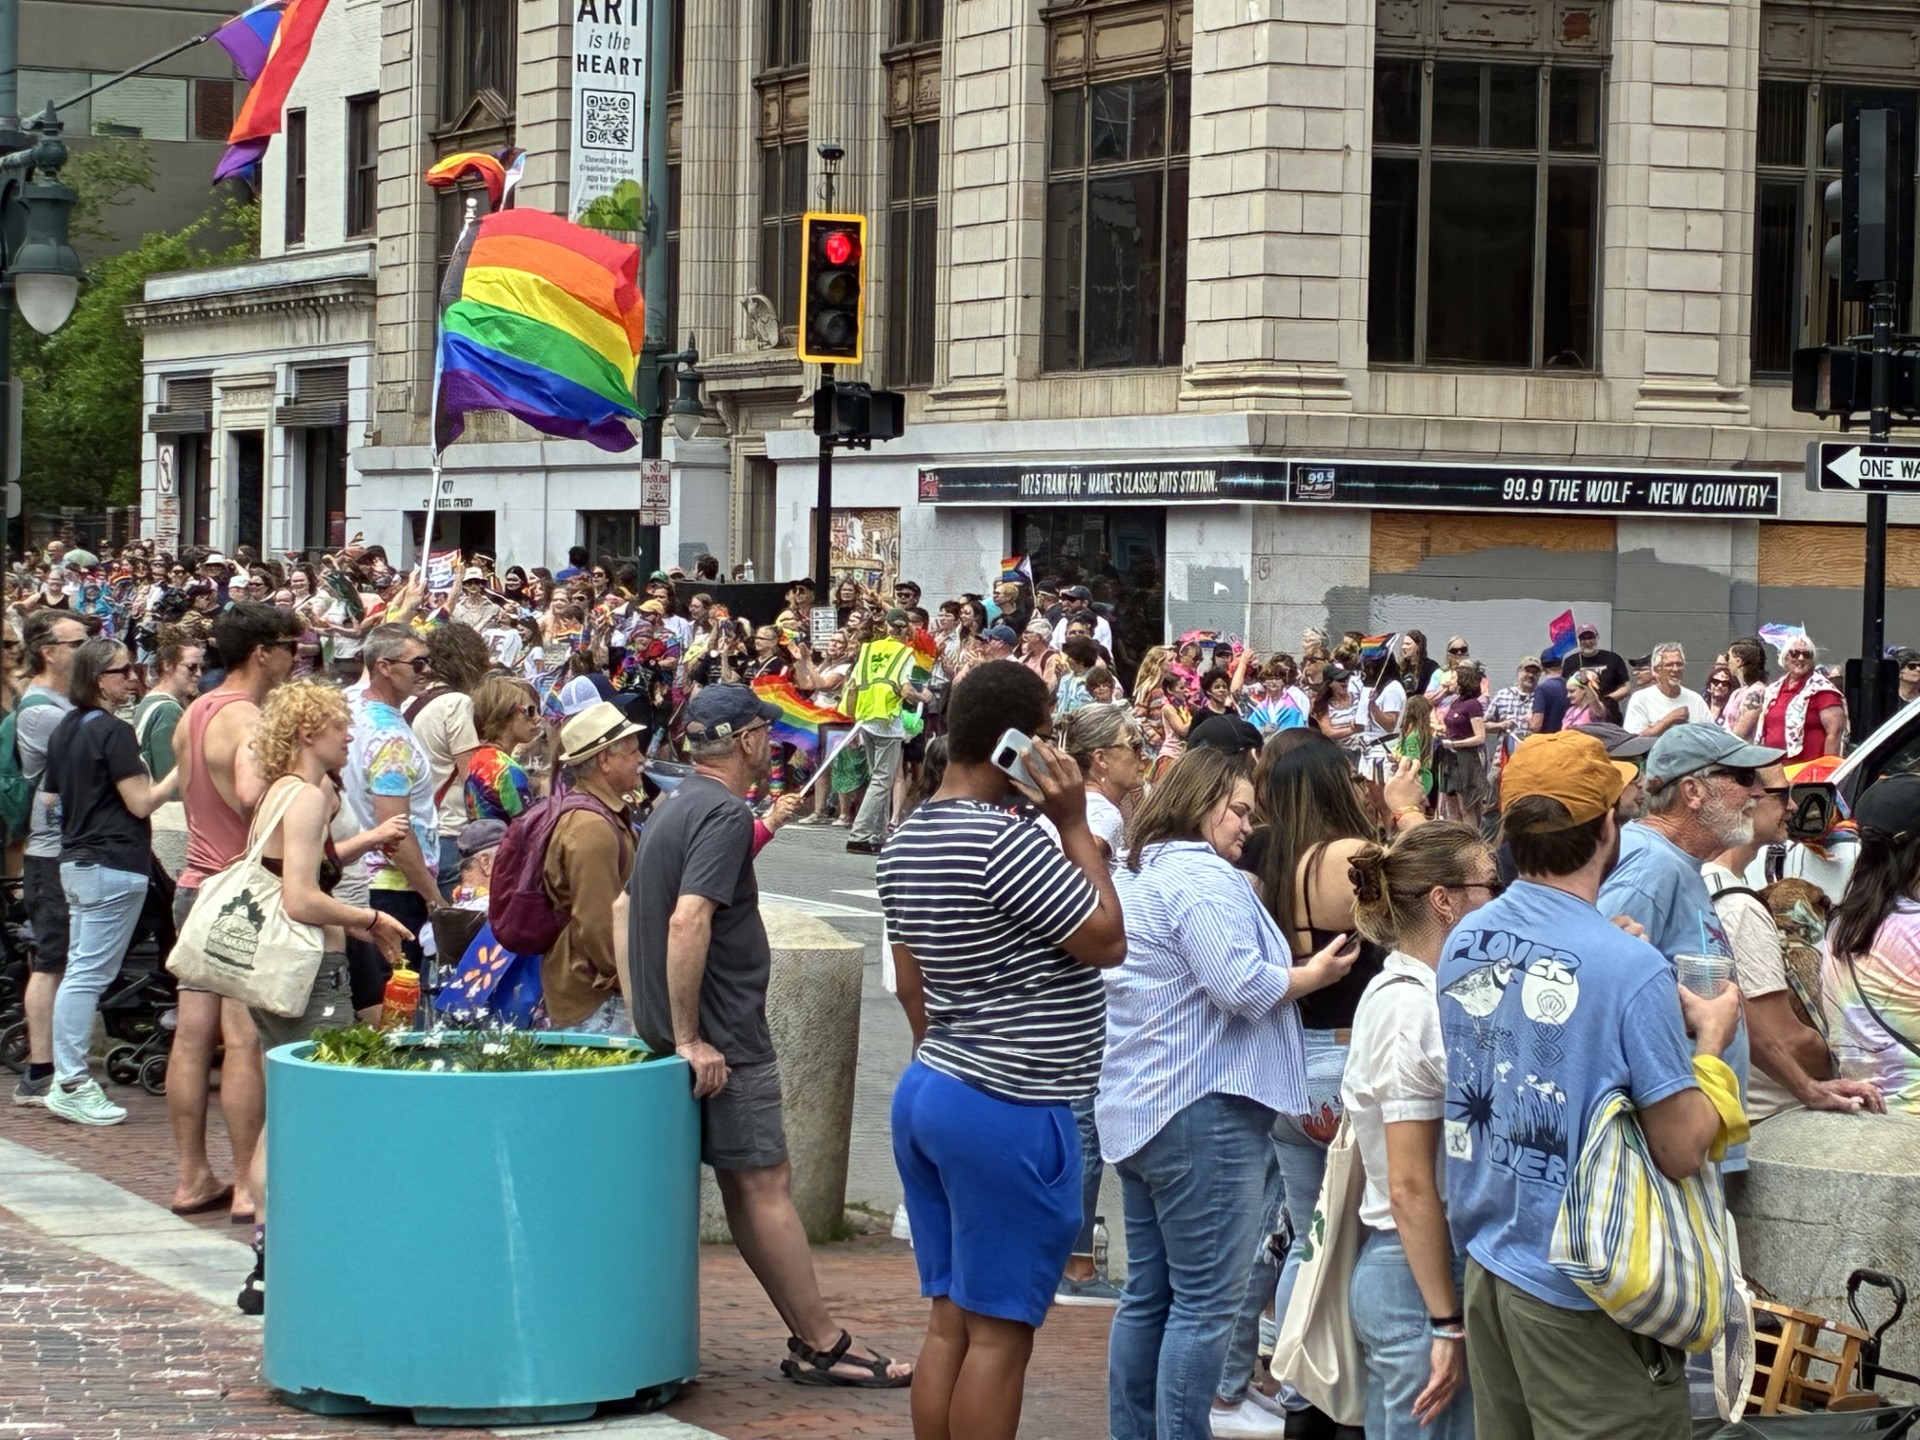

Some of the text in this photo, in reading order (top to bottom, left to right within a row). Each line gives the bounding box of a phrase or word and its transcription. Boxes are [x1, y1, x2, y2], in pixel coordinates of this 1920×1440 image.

[588, 28, 631, 51] is the
[577, 53, 643, 77] HEART
[1860, 459, 1920, 479] ONE WA
[1122, 471, 1159, 494] CLASSIC
[1158, 471, 1180, 494] HITS
[1502, 477, 1543, 501] 99.9
[1548, 479, 1582, 502] THE
[1585, 480, 1633, 503] WOLF
[1648, 481, 1689, 505] NEW
[1691, 482, 1770, 507] COUNTRY
